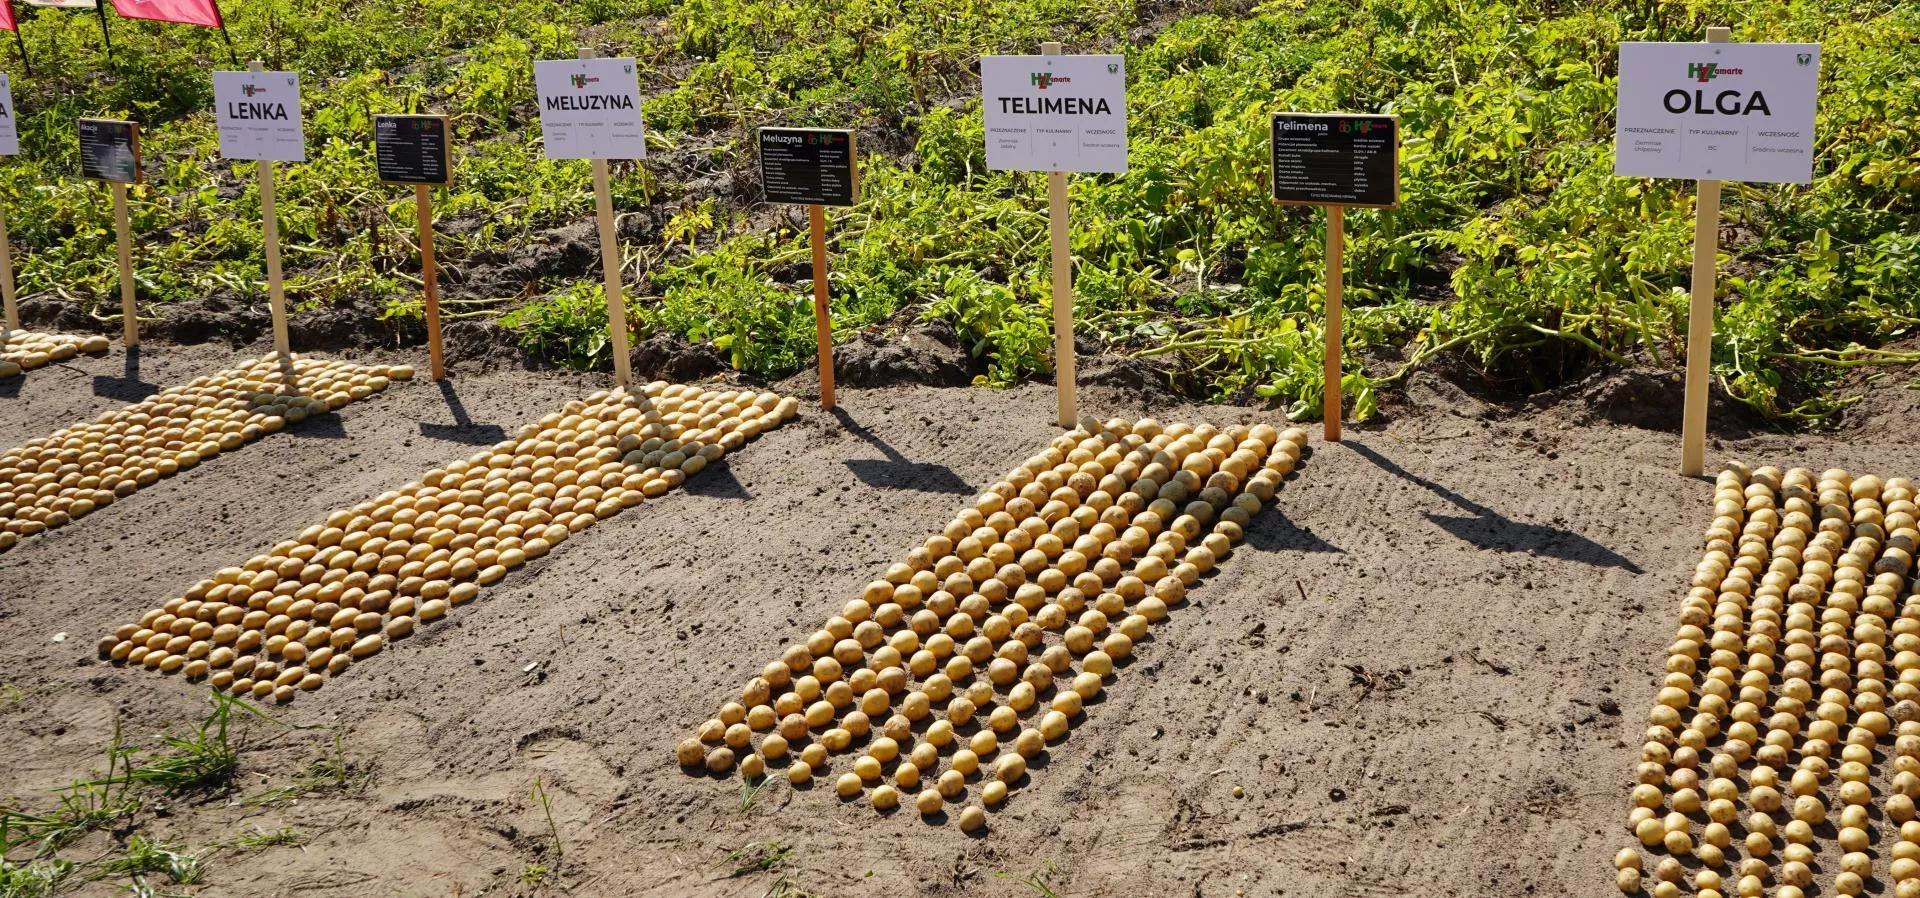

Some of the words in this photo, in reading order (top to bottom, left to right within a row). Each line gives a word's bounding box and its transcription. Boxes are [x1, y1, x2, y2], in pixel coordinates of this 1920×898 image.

[546, 95, 634, 111] MELUZYNA
[998, 97, 1112, 115] TELIMENA
[1663, 89, 1771, 116] OLGA
[228, 102, 289, 120] LENKA
[1277, 121, 1329, 131] Telimena
[1624, 127, 1676, 135] PRZEZNACZENIE
[763, 134, 803, 144] Meluzyna
